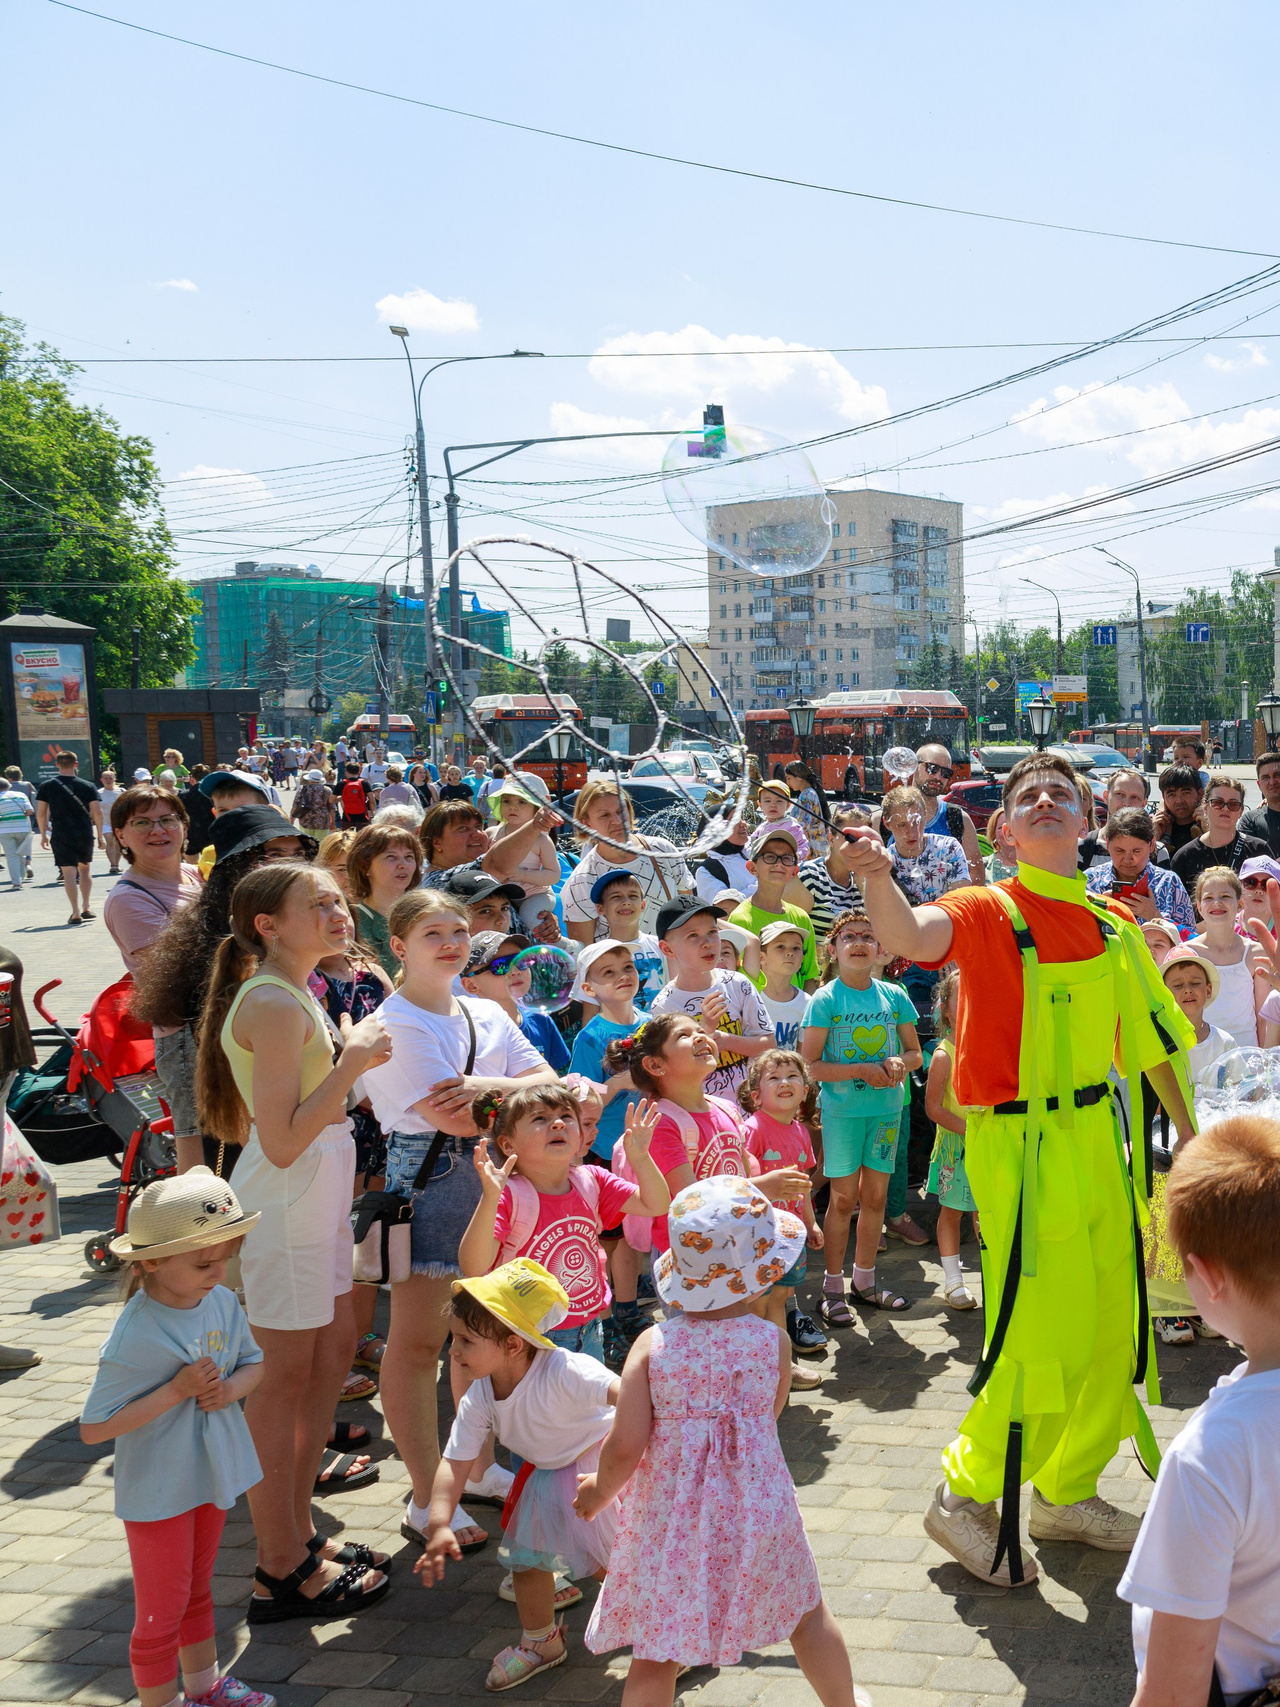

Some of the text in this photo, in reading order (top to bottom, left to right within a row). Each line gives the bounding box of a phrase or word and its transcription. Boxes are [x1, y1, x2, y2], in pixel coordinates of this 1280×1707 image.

[25, 657, 58, 665] ВКУСНО
[439, 681, 448, 693] 9
[845, 1011, 891, 1024] never
[583, 1297, 596, 1308] UK
